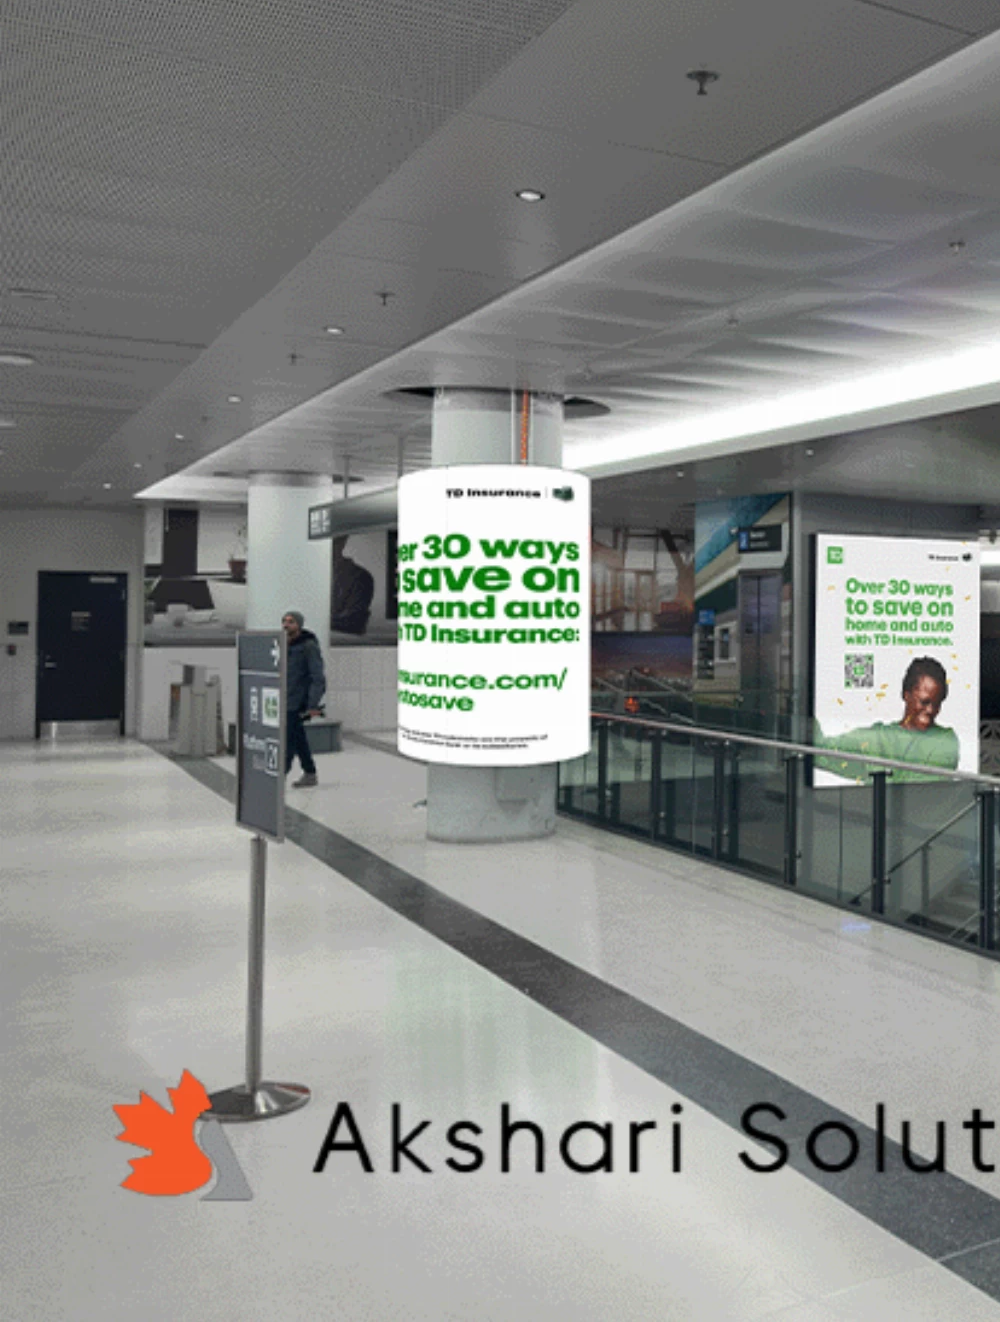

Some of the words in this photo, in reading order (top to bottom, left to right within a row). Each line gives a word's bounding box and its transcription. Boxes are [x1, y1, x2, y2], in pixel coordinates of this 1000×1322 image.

[446, 488, 463, 498] TD
[467, 488, 541, 498] Insurance
[422, 533, 471, 560] 30
[480, 539, 580, 565] ways
[402, 566, 511, 593] save
[522, 566, 580, 593] on
[846, 578, 885, 594] Over
[888, 579, 910, 595] 30
[914, 583, 954, 598] ways
[427, 595, 496, 619] and
[504, 597, 580, 619] auto
[845, 597, 868, 615] to
[873, 599, 922, 616] save
[927, 601, 954, 616] on
[404, 623, 427, 642] TD
[431, 624, 580, 644] Insurance:
[845, 617, 887, 631] home
[890, 619, 917, 632] and
[920, 621, 954, 632] auto
[845, 634, 872, 645] with
[874, 634, 890, 645] TD
